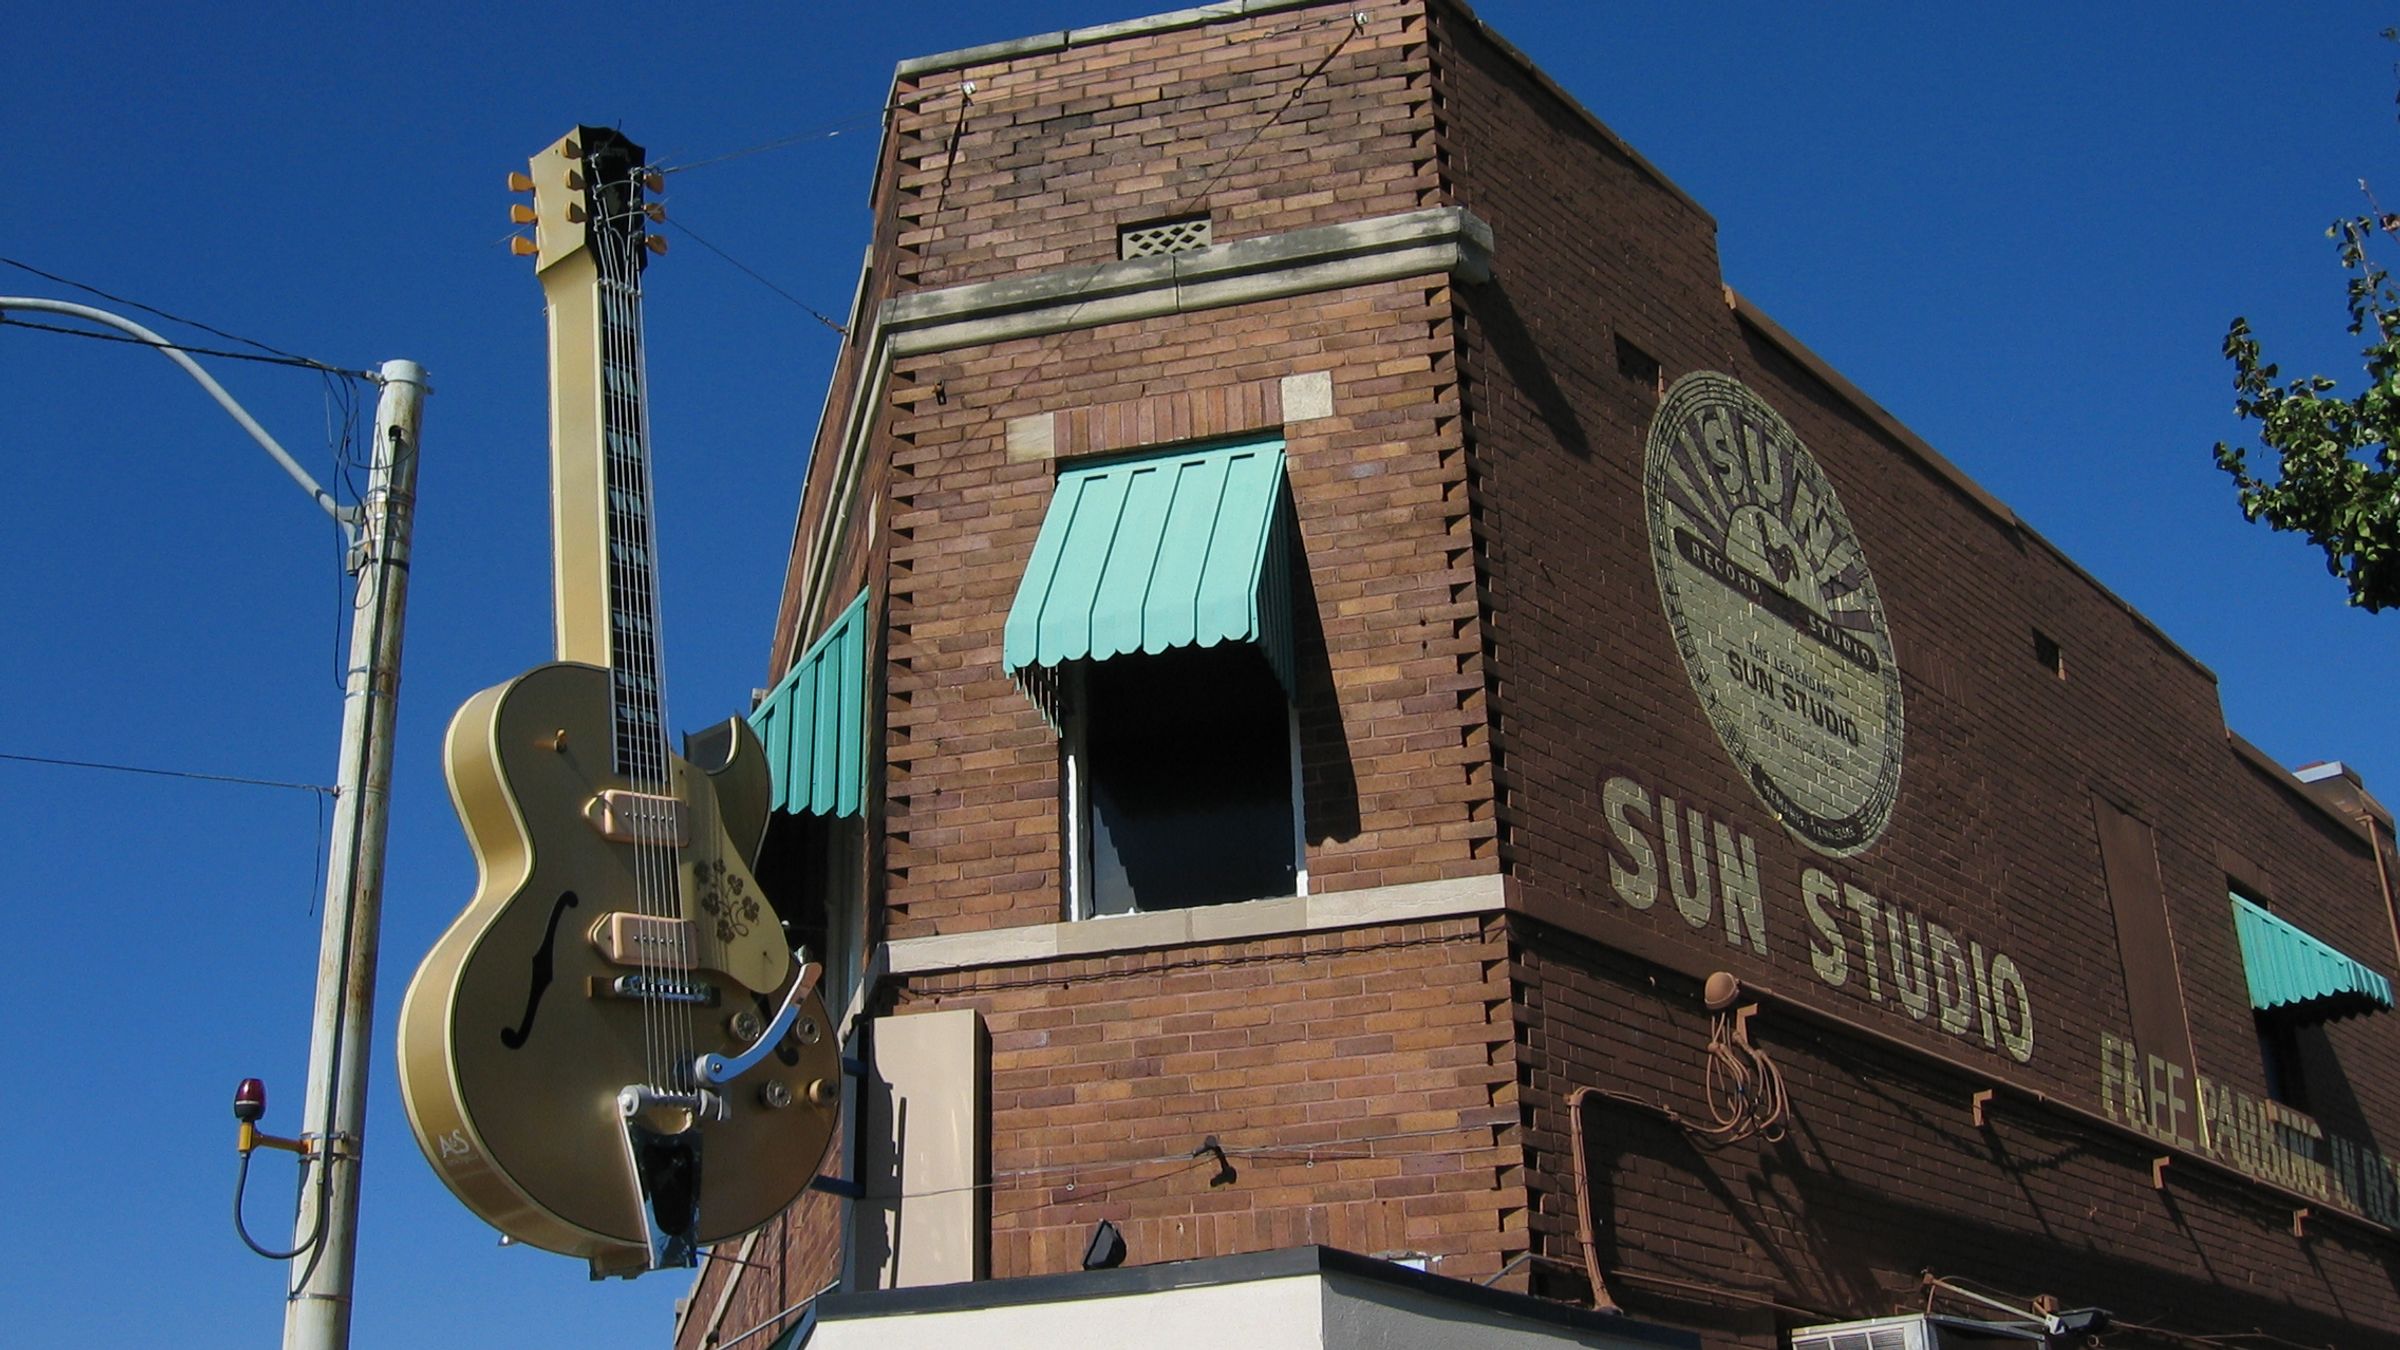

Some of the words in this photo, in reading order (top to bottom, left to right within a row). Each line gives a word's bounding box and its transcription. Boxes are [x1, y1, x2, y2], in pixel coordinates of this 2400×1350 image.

[1691, 541, 1760, 595] RECORD
[1808, 614, 1870, 666] STUDIO
[1747, 640, 1769, 665] THE
[1728, 650, 1775, 700] SUN
[1781, 681, 1859, 747] STUDIO
[1602, 776, 1768, 957] SUN
[1801, 867, 2034, 1064] STUDIO
